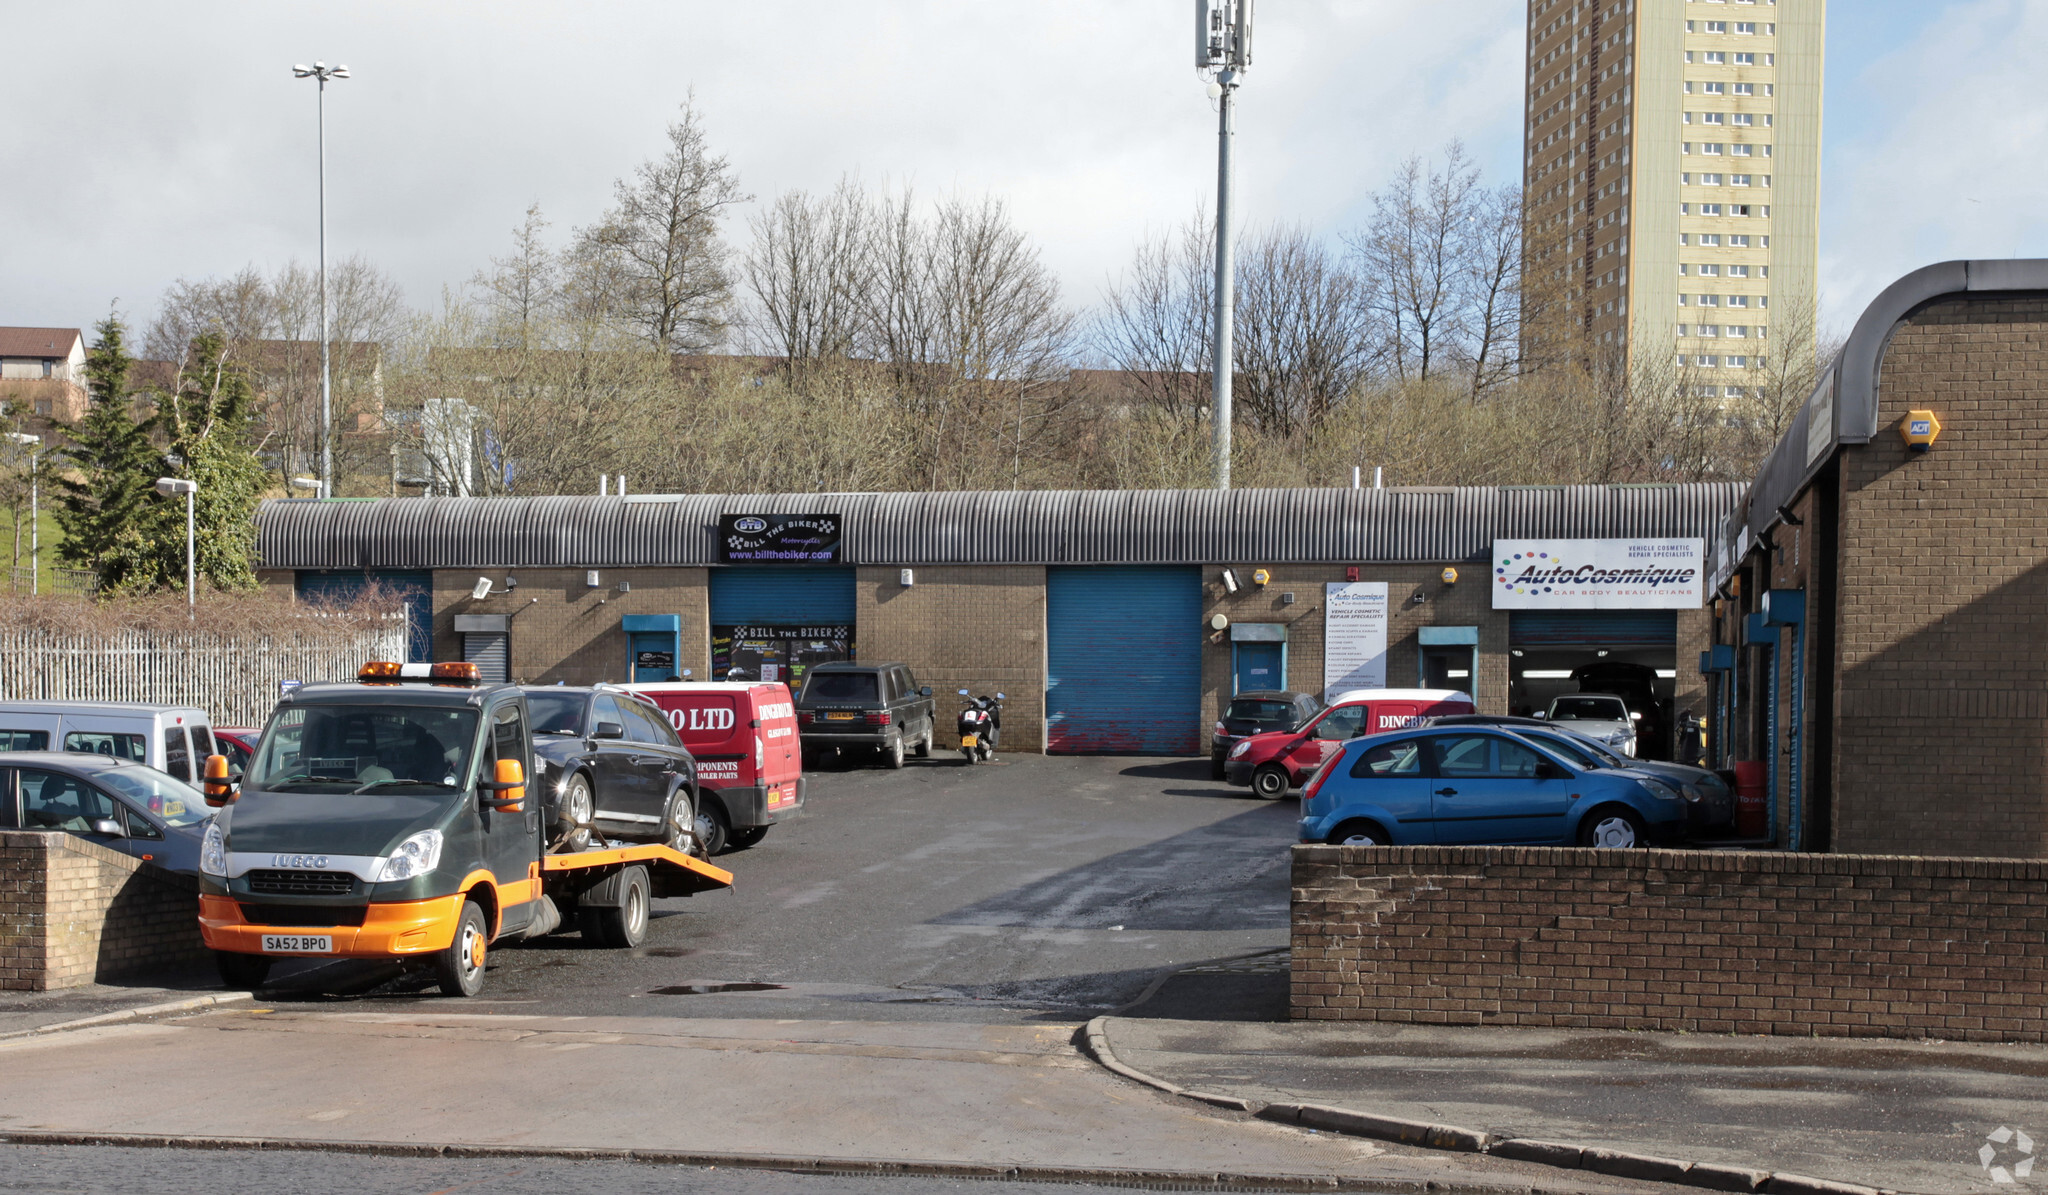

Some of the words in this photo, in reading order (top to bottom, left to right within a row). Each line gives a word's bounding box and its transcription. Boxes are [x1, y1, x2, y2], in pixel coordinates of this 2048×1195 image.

[1911, 424, 1930, 432] ADT
[740, 520, 762, 530] BTB
[744, 538, 765, 548] BILL
[766, 524, 785, 538] THE
[788, 520, 818, 529] BIKER
[729, 550, 832, 559] www.billthebiker.com
[1513, 564, 1696, 588] AutoCosmique
[1352, 593, 1385, 601] Cosmique
[750, 628, 775, 638] BILL
[800, 627, 832, 637] BIKER
[689, 708, 735, 730] LTD
[271, 855, 329, 868] IVECO
[266, 937, 298, 950] SA52
[302, 938, 326, 950] BPO
